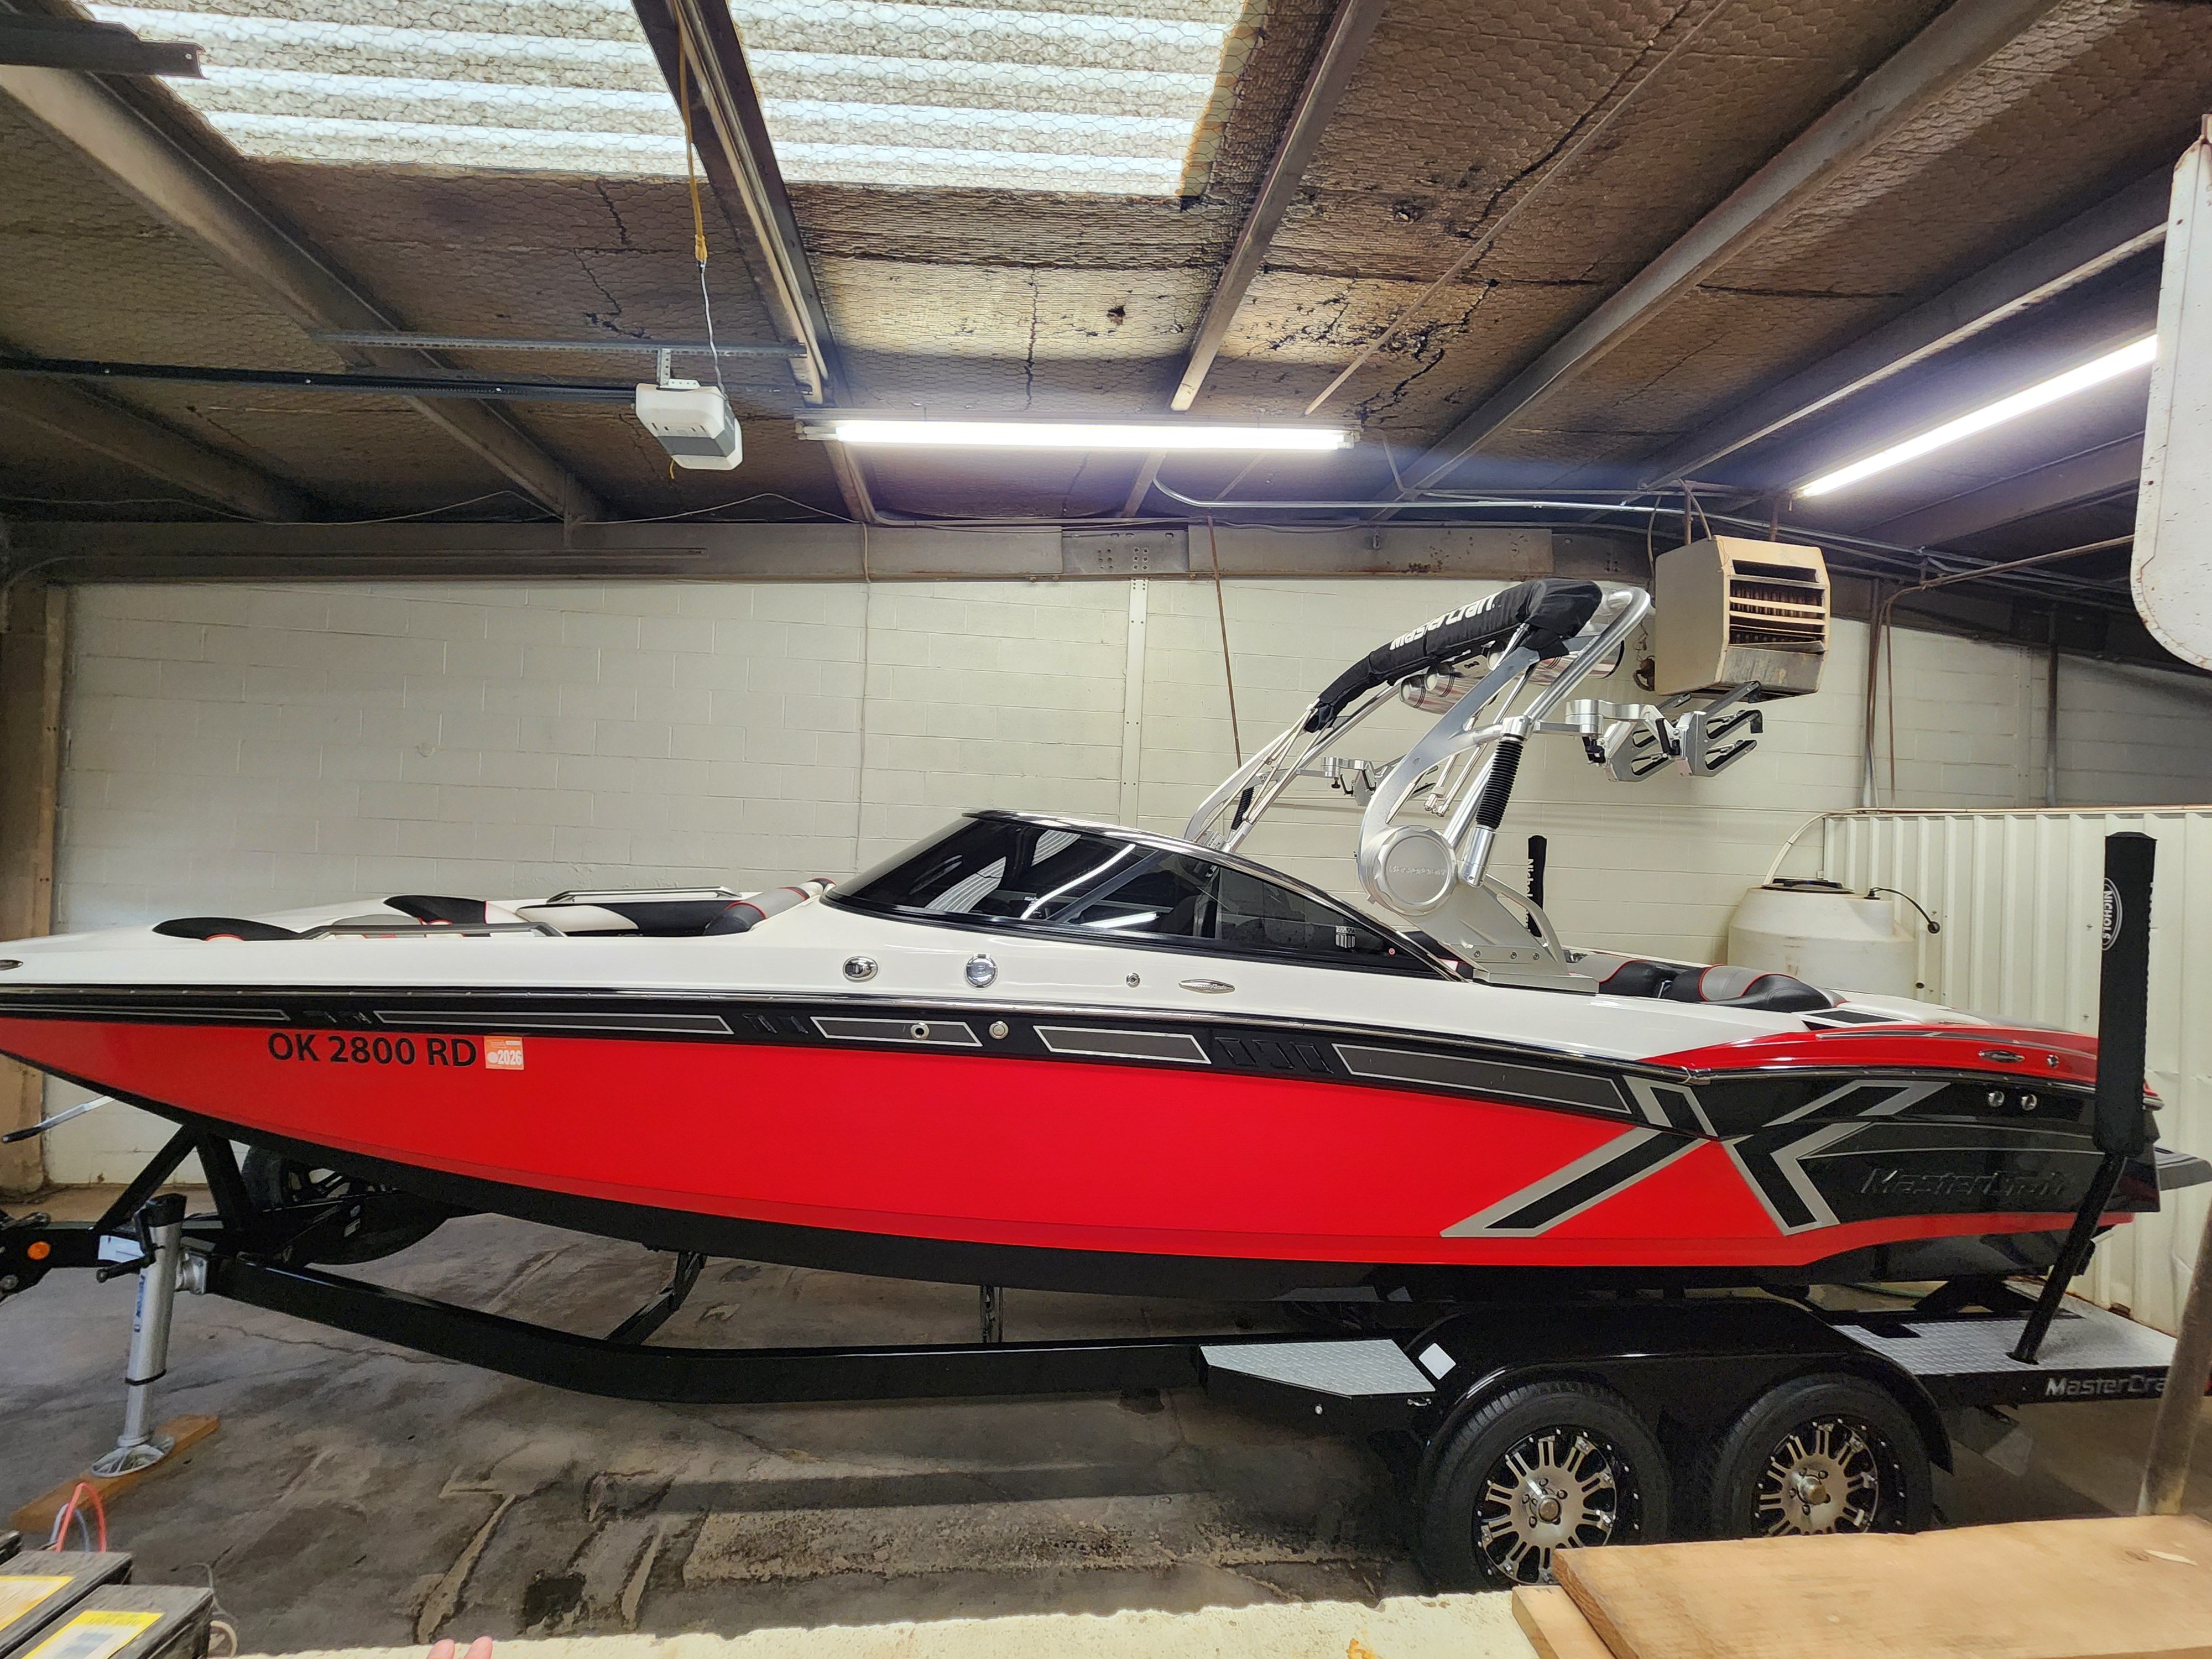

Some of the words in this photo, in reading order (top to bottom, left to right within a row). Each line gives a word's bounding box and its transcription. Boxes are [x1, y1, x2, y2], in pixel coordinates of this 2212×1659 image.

[2103, 890, 2113, 940] NICHOLS
[268, 1032, 319, 1061] OK
[327, 1035, 415, 1065] 2800
[426, 1037, 477, 1066] RD
[498, 1050, 523, 1065] 2026
[2046, 1375, 2165, 1396] MasterCra
